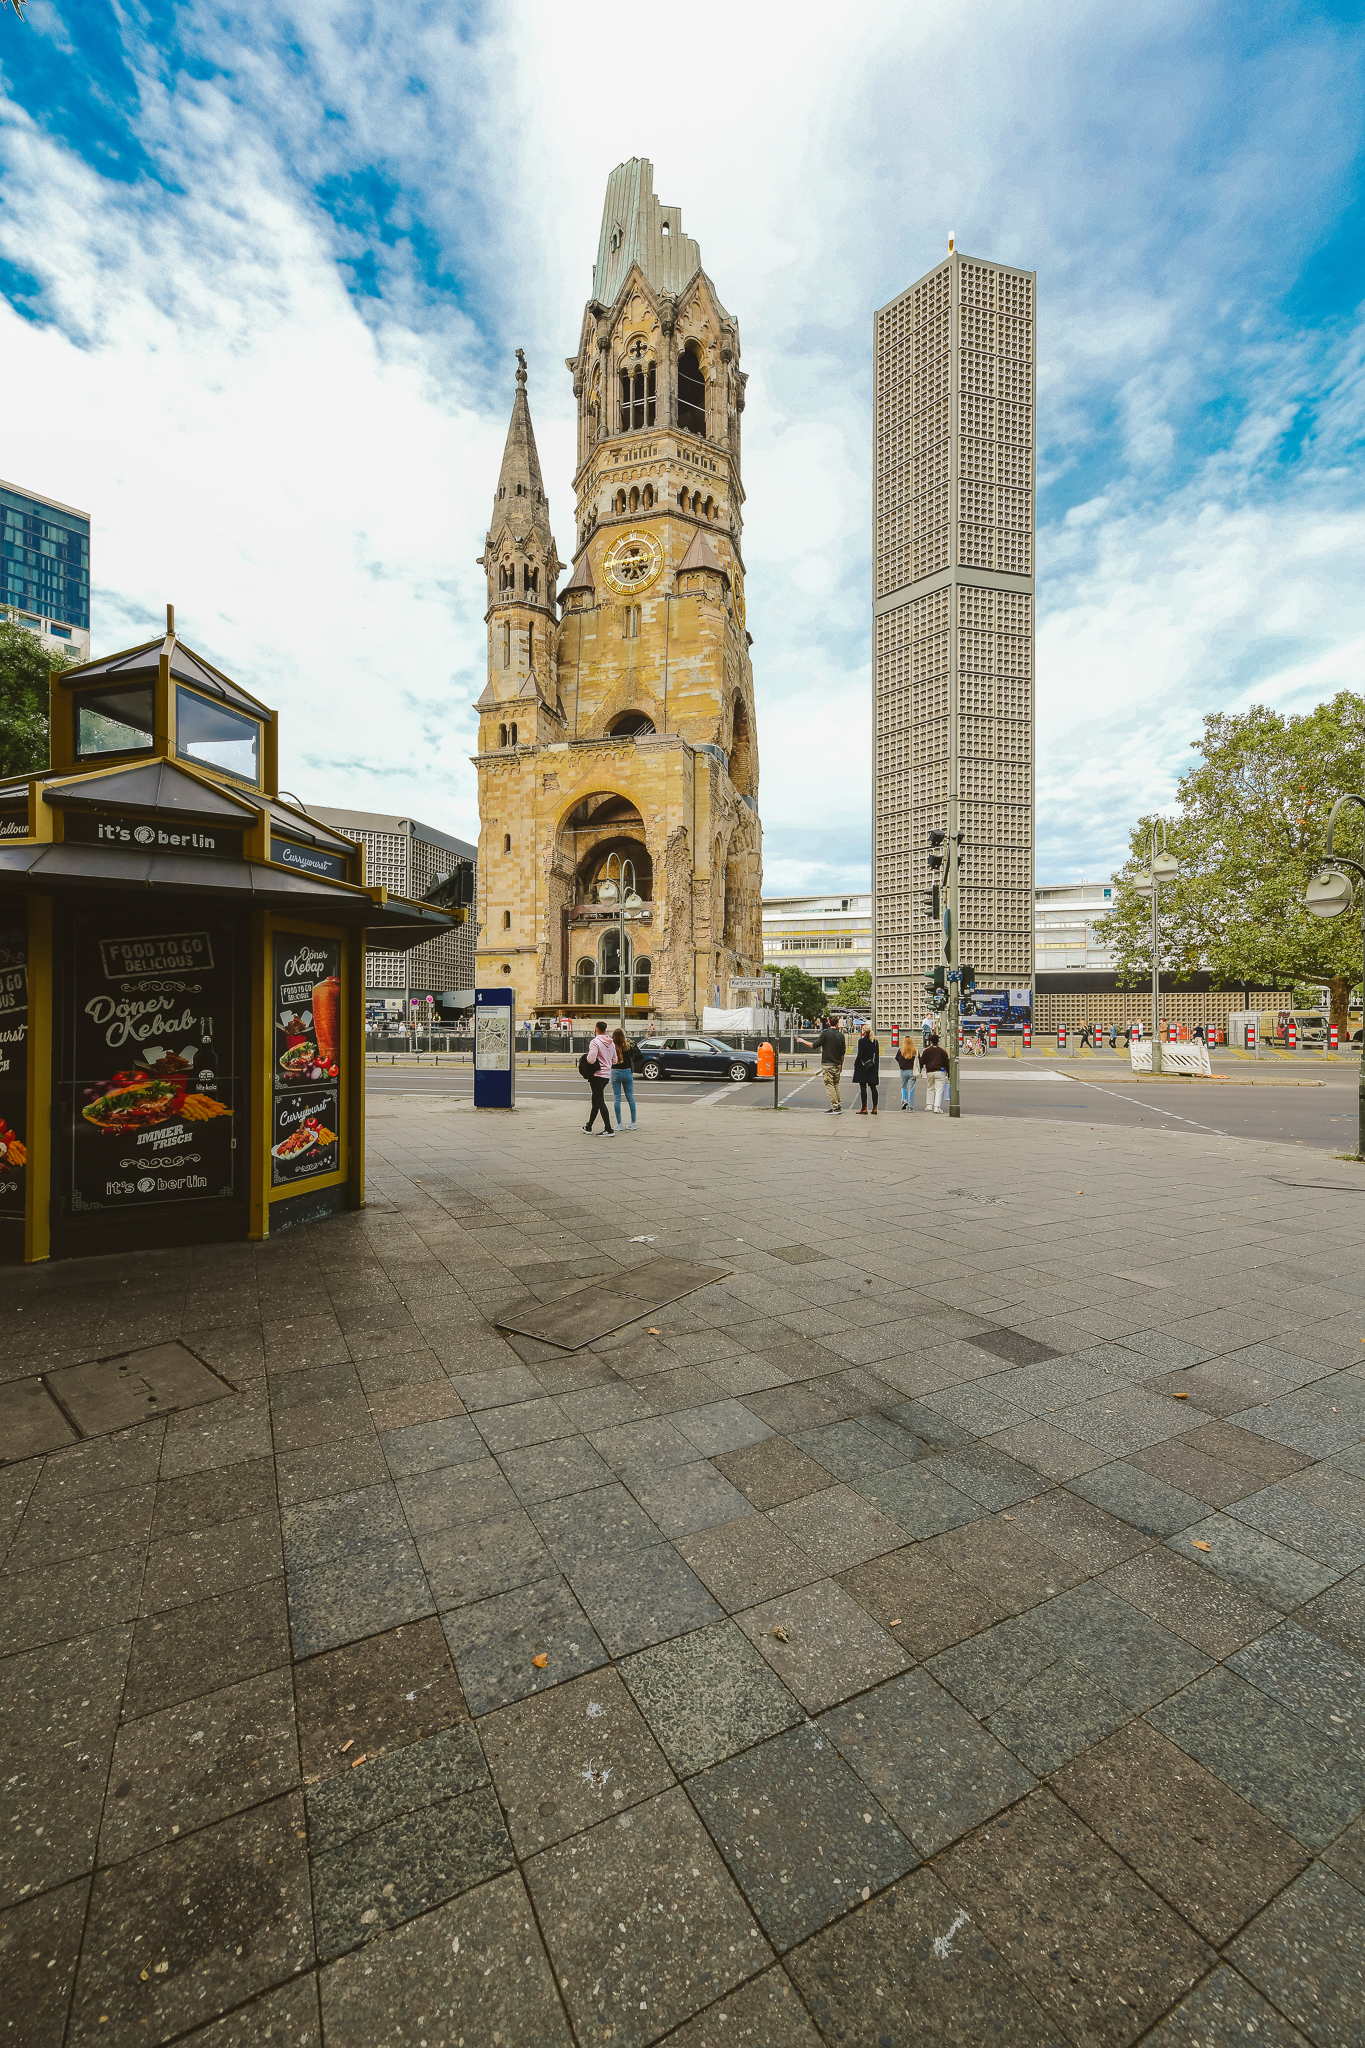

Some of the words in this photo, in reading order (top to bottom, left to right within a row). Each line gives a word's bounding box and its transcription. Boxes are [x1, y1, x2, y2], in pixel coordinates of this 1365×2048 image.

[98, 823, 131, 841] it's
[157, 830, 215, 849] berlin
[282, 848, 333, 871] Currywurst
[109, 942, 155, 960] FOOD
[156, 940, 178, 954] TO
[181, 938, 203, 953] GO
[300, 946, 328, 961] Döner
[124, 955, 194, 972] DELICIOUS
[284, 955, 325, 978] Kebap
[84, 995, 175, 1024] Döner
[105, 1008, 198, 1048] Kebab
[279, 1097, 332, 1126] Currywurst
[136, 1124, 184, 1146] IMMER
[152, 1132, 193, 1151] FRISCH
[106, 1180, 135, 1195] it's
[157, 1174, 208, 1191] berlin
